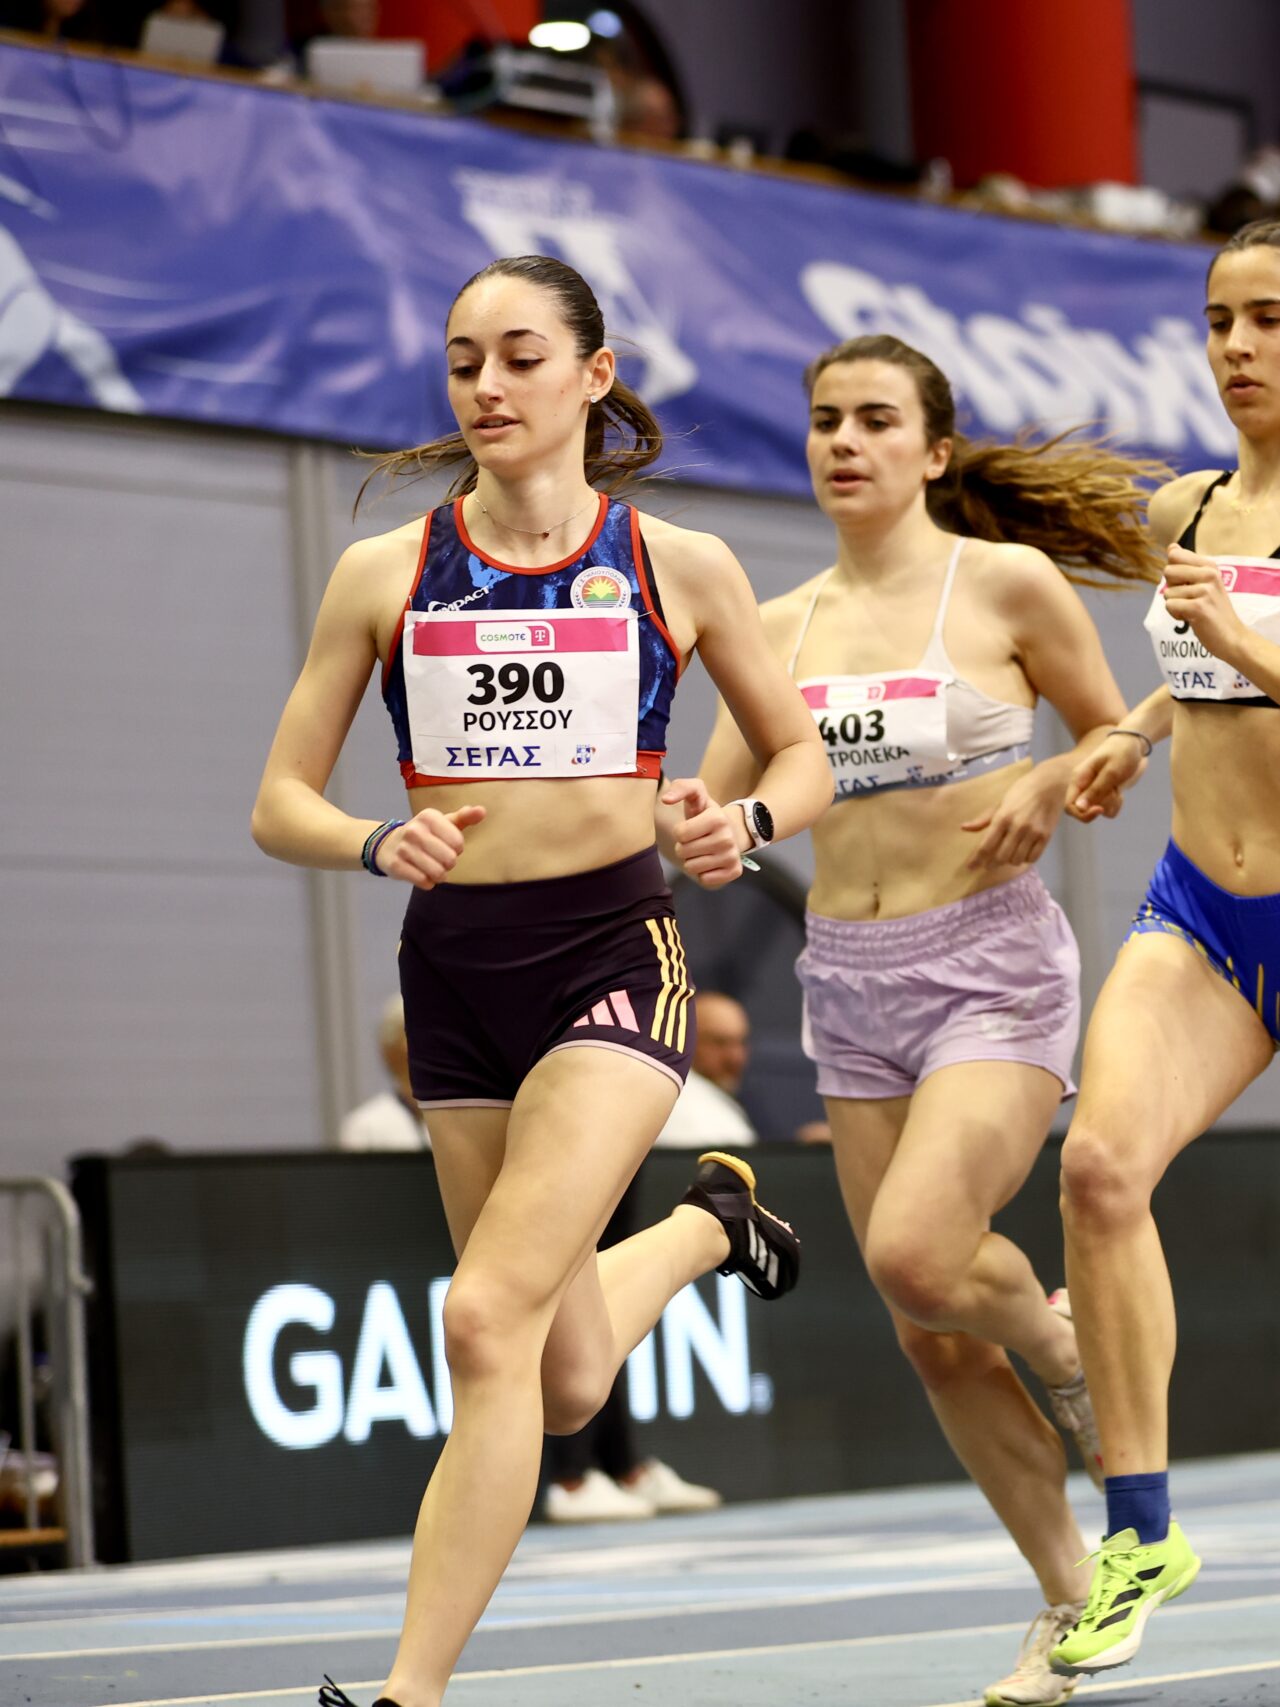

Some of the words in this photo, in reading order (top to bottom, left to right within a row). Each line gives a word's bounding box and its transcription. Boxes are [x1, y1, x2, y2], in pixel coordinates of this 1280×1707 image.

[480, 633, 526, 642] COSMOTE
[1160, 640, 1214, 658] ΟΙΚΟΝΟ
[466, 661, 565, 706] 390
[463, 709, 573, 732] ΡΟΥΣΣΟΥ
[819, 709, 885, 747] 403
[445, 745, 542, 767] ΣΕΓΑΣ
[827, 745, 910, 768] ΤΡΟΛΕΚΑ
